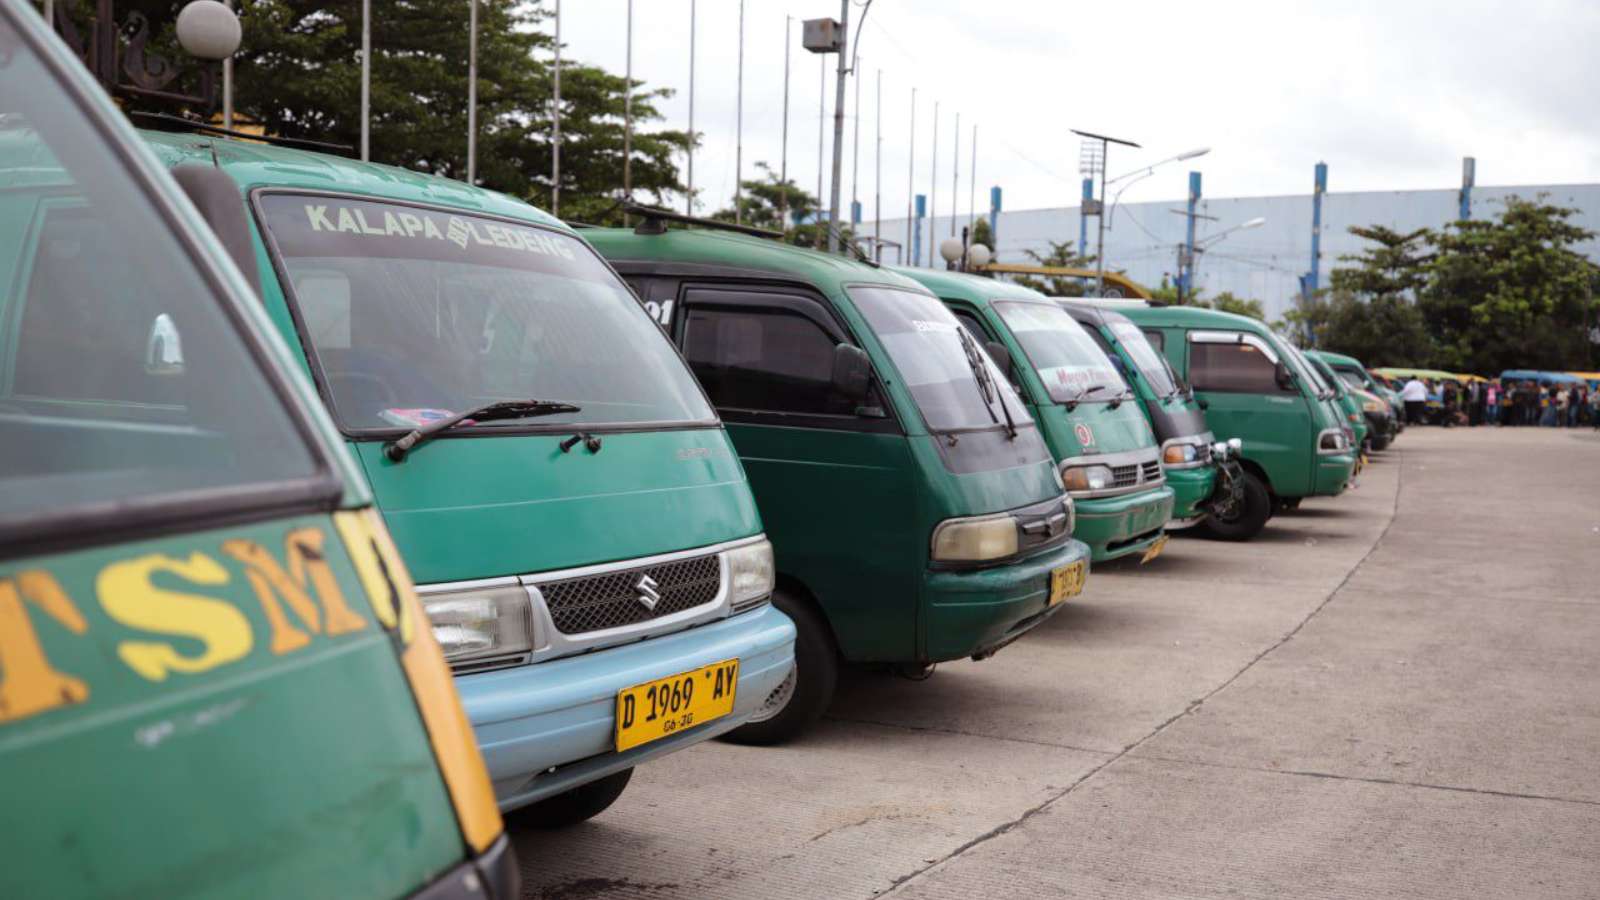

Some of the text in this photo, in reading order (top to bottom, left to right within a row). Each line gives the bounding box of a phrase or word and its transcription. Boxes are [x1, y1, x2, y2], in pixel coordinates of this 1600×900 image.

[304, 204, 577, 261] KALAPA LEDENG
[622, 664, 736, 730] D 1969 AY
